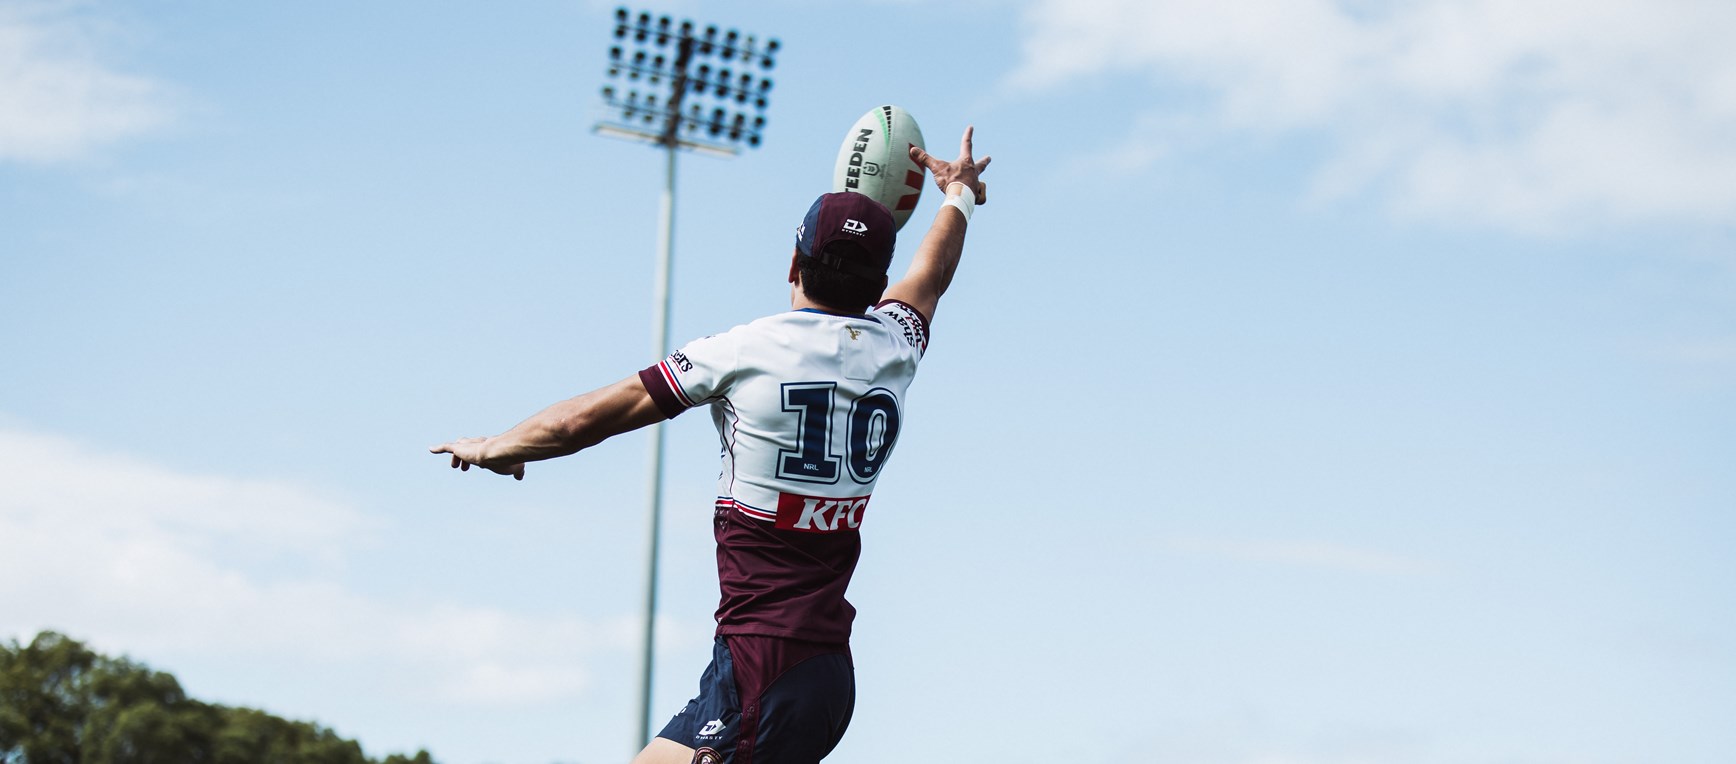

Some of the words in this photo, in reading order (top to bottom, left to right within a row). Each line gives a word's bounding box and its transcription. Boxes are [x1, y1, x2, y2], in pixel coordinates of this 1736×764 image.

[671, 350, 693, 372] ers
[775, 381, 900, 485] 10
[803, 463, 820, 471] NRL
[793, 498, 867, 531] KFC
